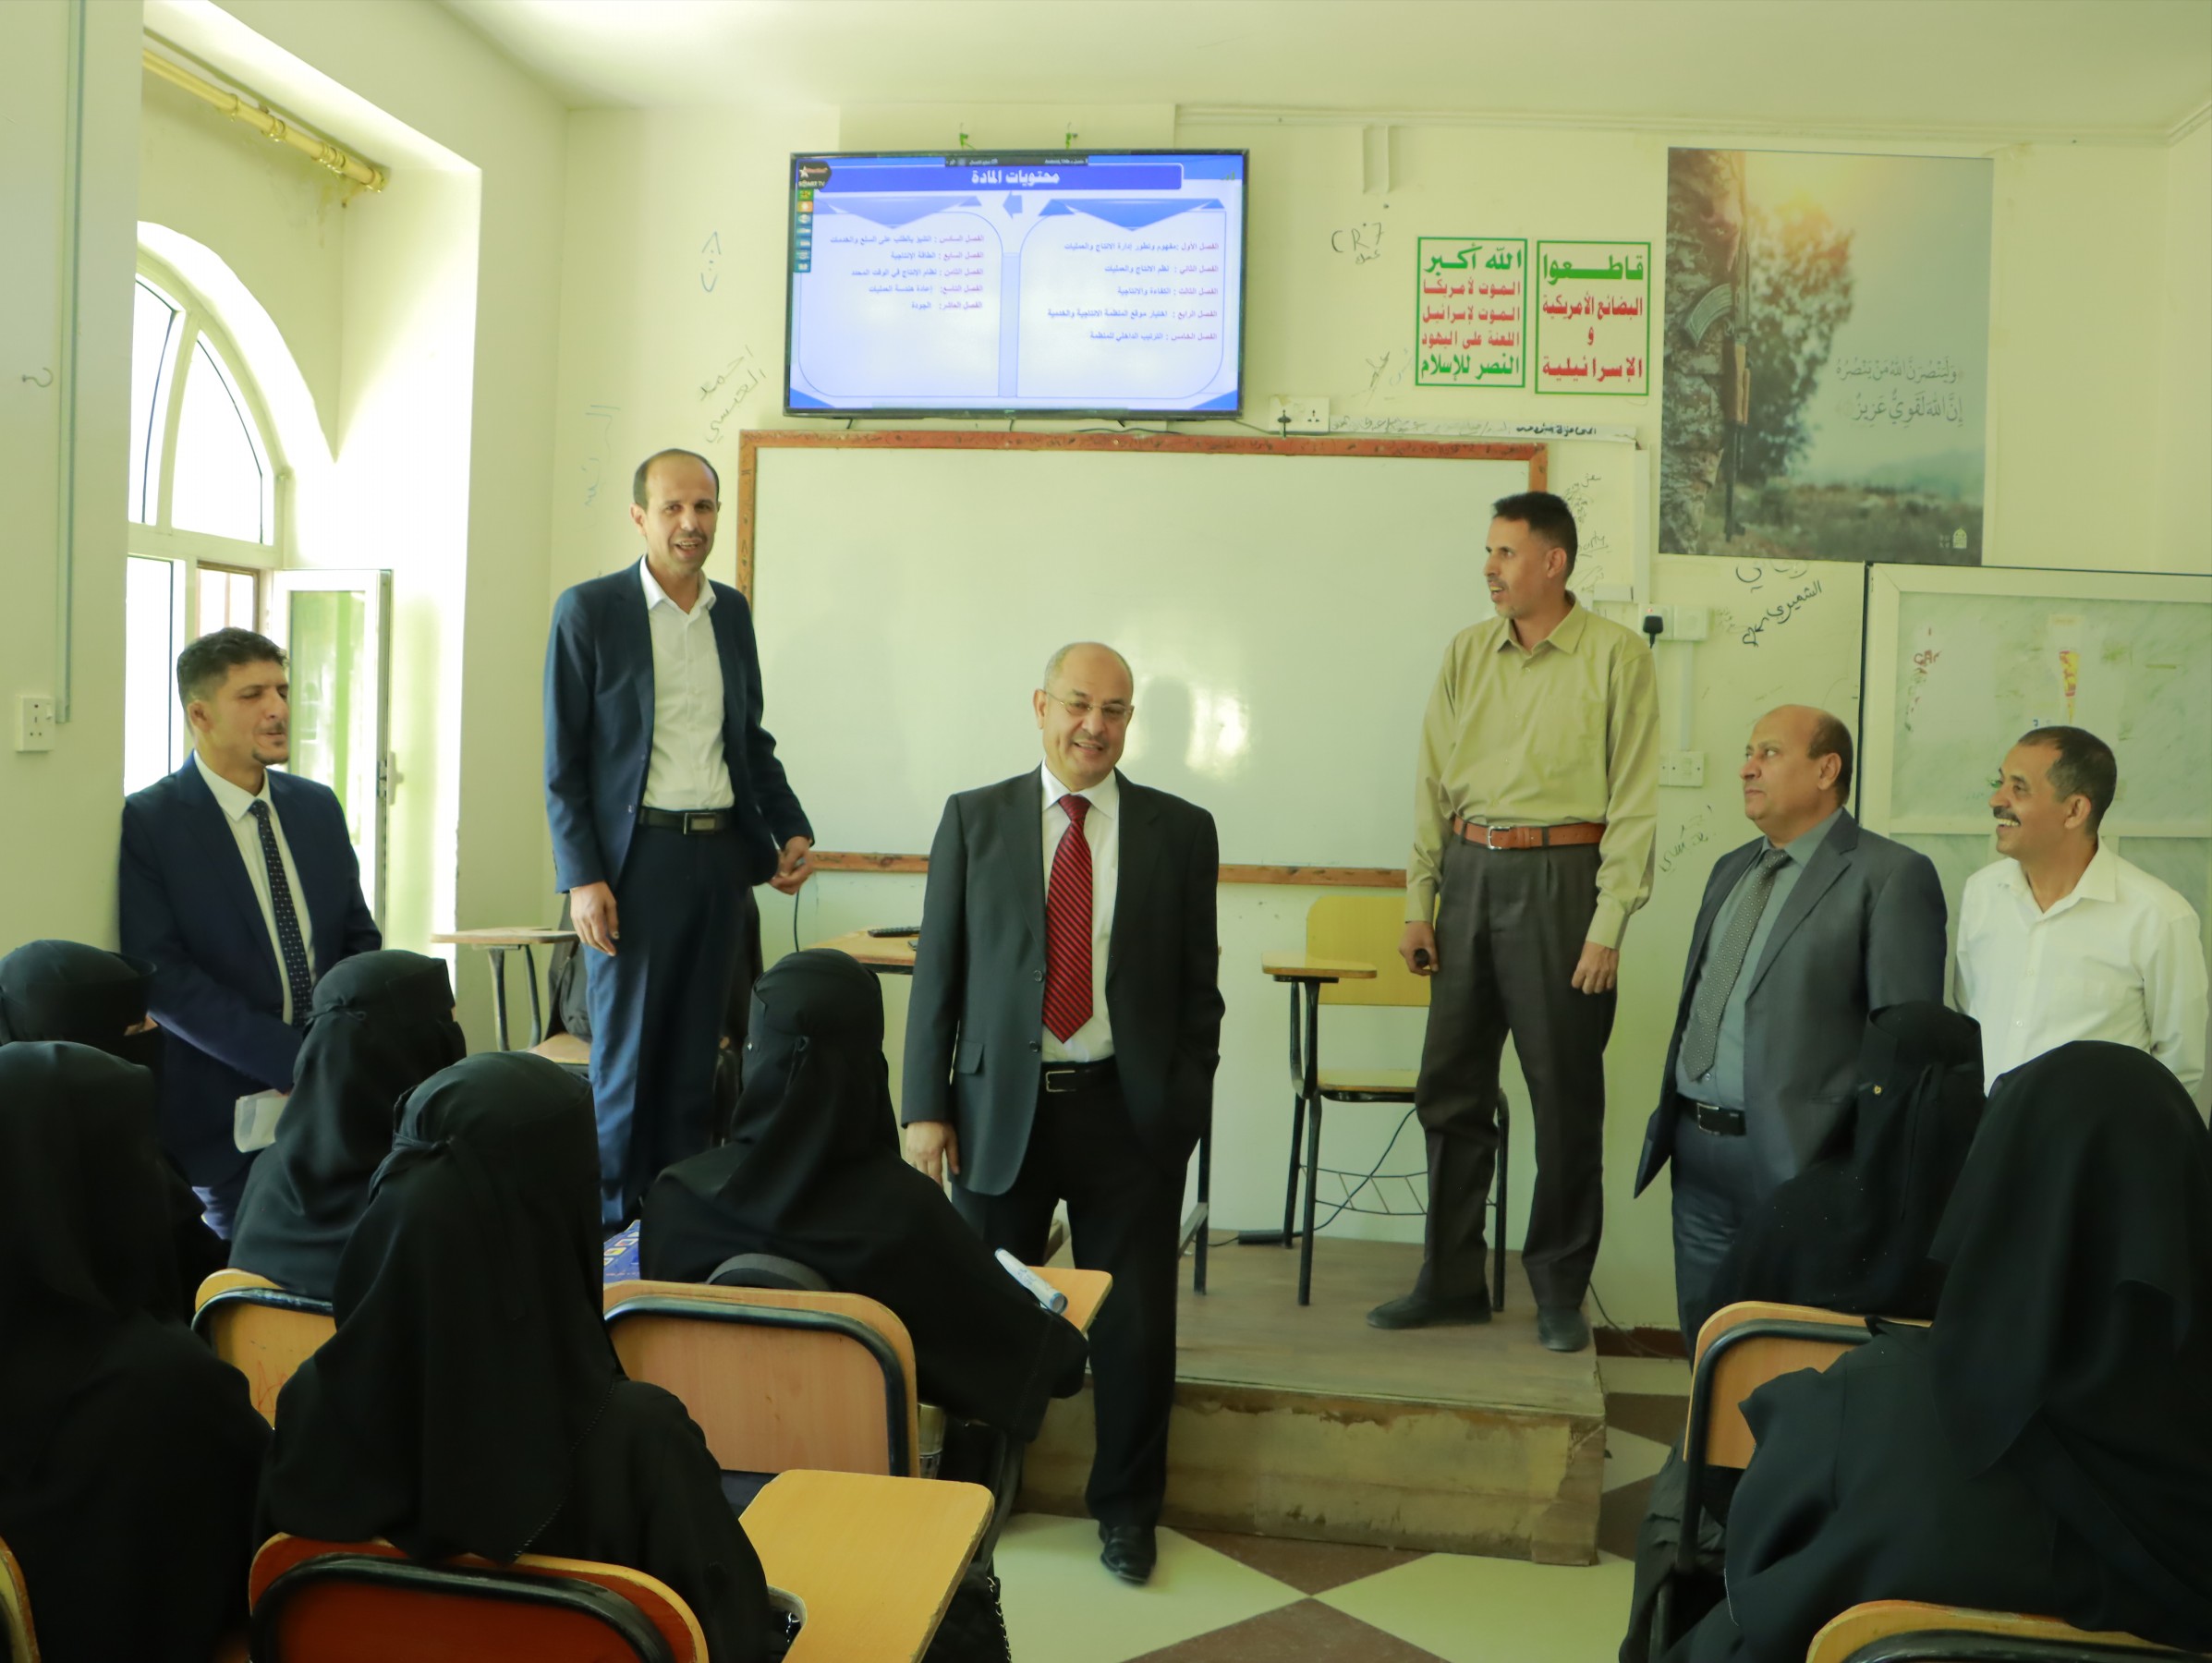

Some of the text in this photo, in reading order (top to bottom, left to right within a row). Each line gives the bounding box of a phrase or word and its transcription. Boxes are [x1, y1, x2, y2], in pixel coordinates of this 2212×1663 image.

[971, 169, 1060, 187] محتويات المادة
[1198, 242, 1219, 251] الفصل
[1423, 242, 1522, 276] الله أكبر
[1198, 265, 1219, 273] الفصل
[1543, 253, 1644, 285] قاطعوا
[1198, 287, 1219, 297] الفصل
[1423, 276, 1520, 298] الموت لأمريكا
[911, 301, 931, 310] الجودة
[963, 301, 982, 310] الفصل
[1197, 310, 1218, 319] الفصل
[1542, 290, 1643, 321] البضائع الأمريكية
[1478, 307, 1520, 324] الموت
[1171, 333, 1196, 341] الخامس
[1197, 333, 1217, 341] الفصل
[1422, 330, 1520, 349] اللعنة على اليهود
[1586, 326, 1595, 346] و
[1421, 354, 1471, 382] للإسلام
[1475, 353, 1519, 380] النصر
[1542, 356, 1643, 382] الإسرائيلية
